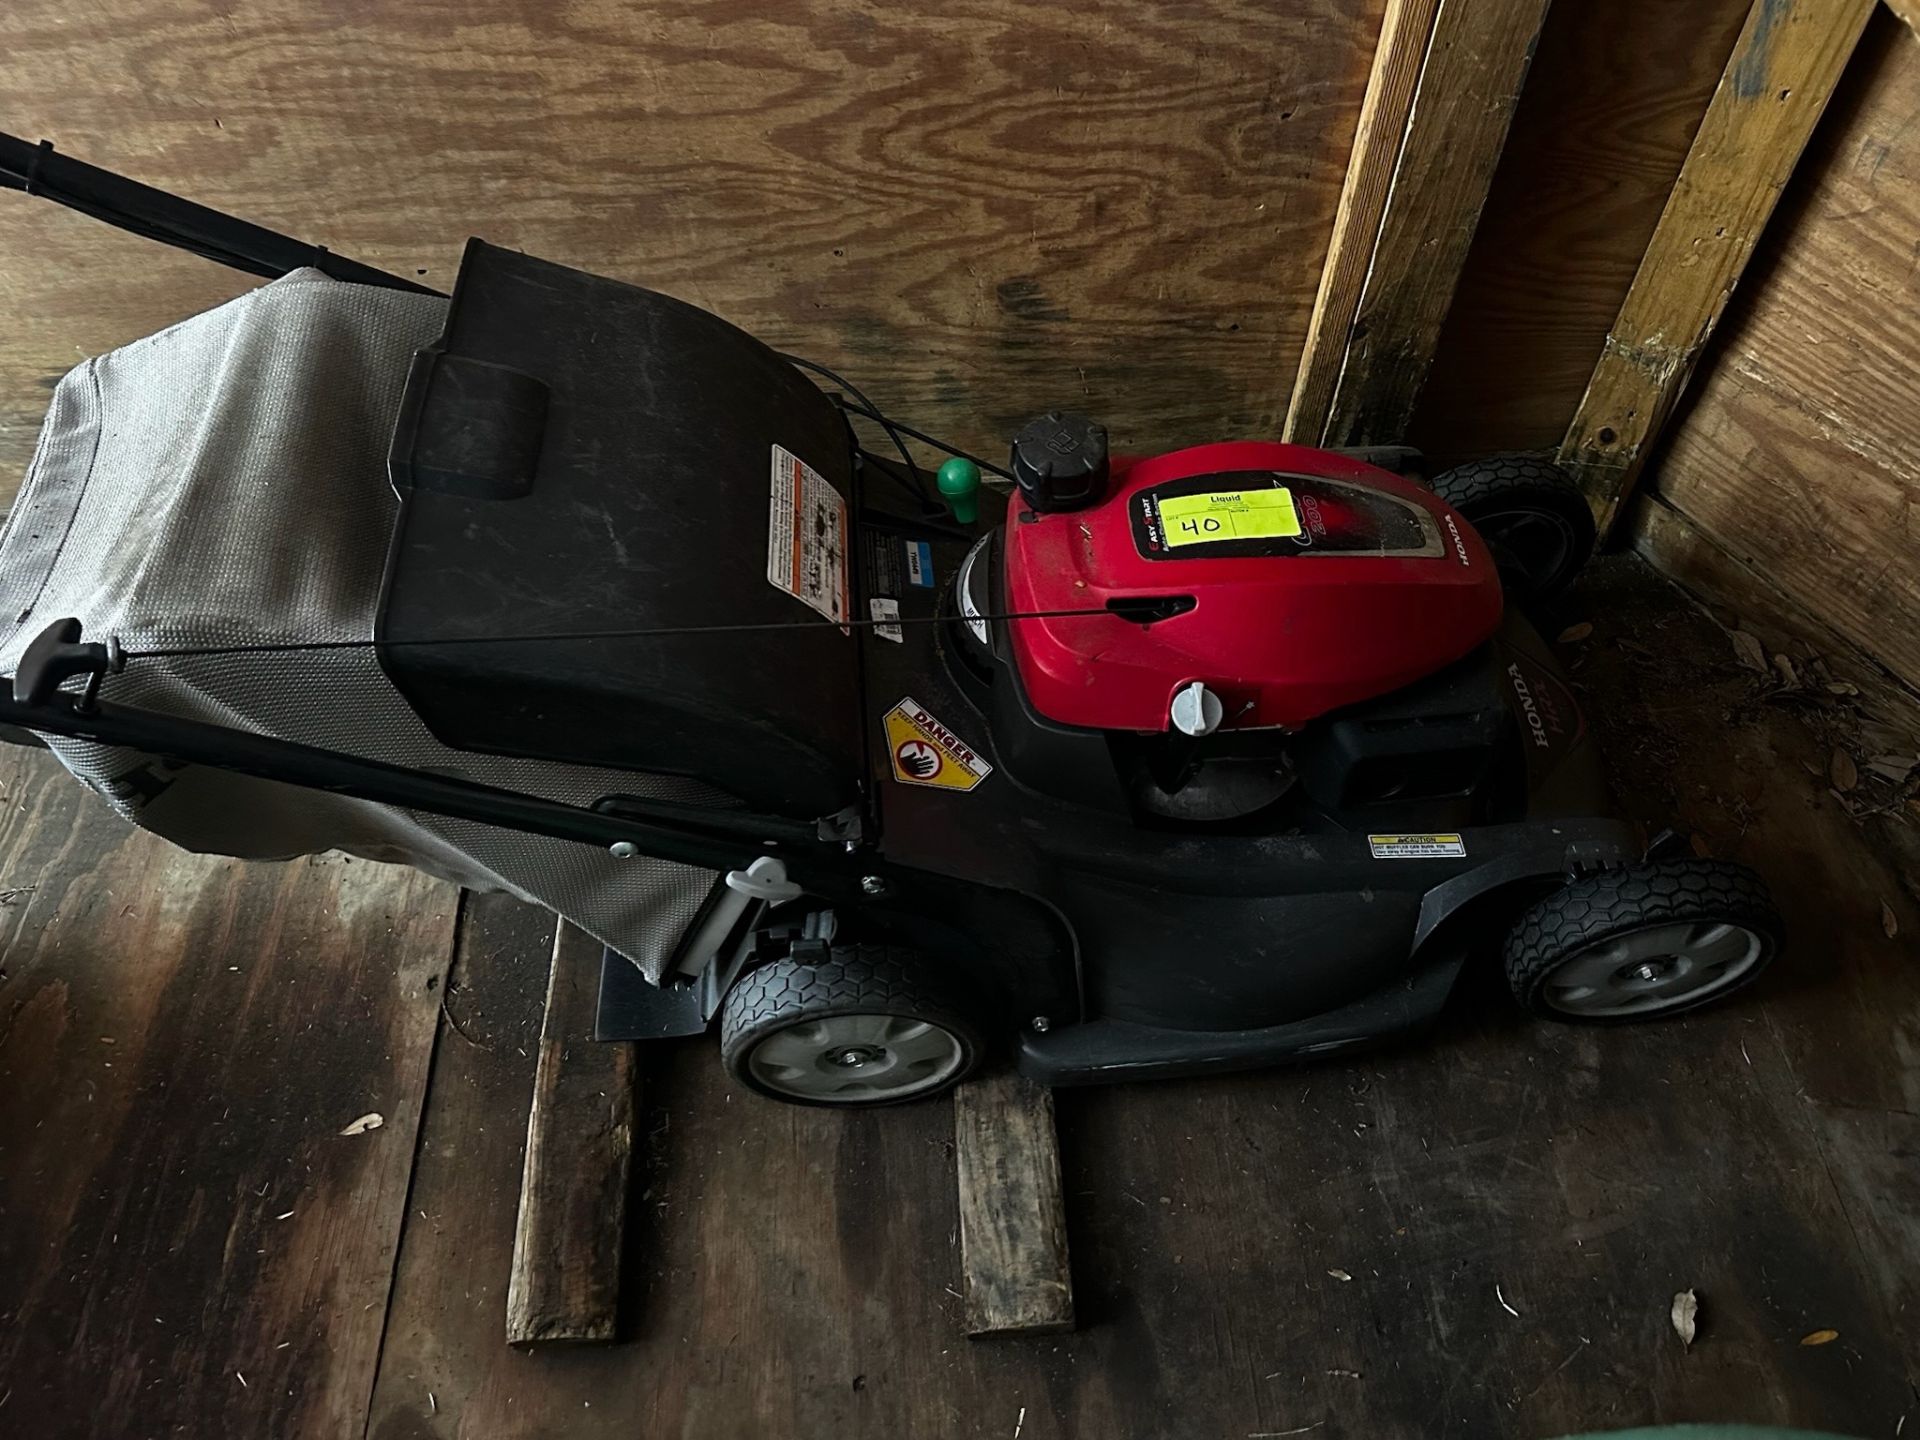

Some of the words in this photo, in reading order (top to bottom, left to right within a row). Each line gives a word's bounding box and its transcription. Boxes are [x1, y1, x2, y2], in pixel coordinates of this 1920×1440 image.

[1210, 494, 1242, 504] Liquid
[1181, 518, 1221, 536] 40
[1444, 513, 1470, 567] HONDA
[1507, 662, 1550, 748] HONDA
[897, 711, 912, 727] KEEP
[912, 723, 933, 743] HANDS
[943, 750, 958, 764] FEET
[957, 762, 975, 778] AWAY
[913, 711, 976, 764] DANGER
